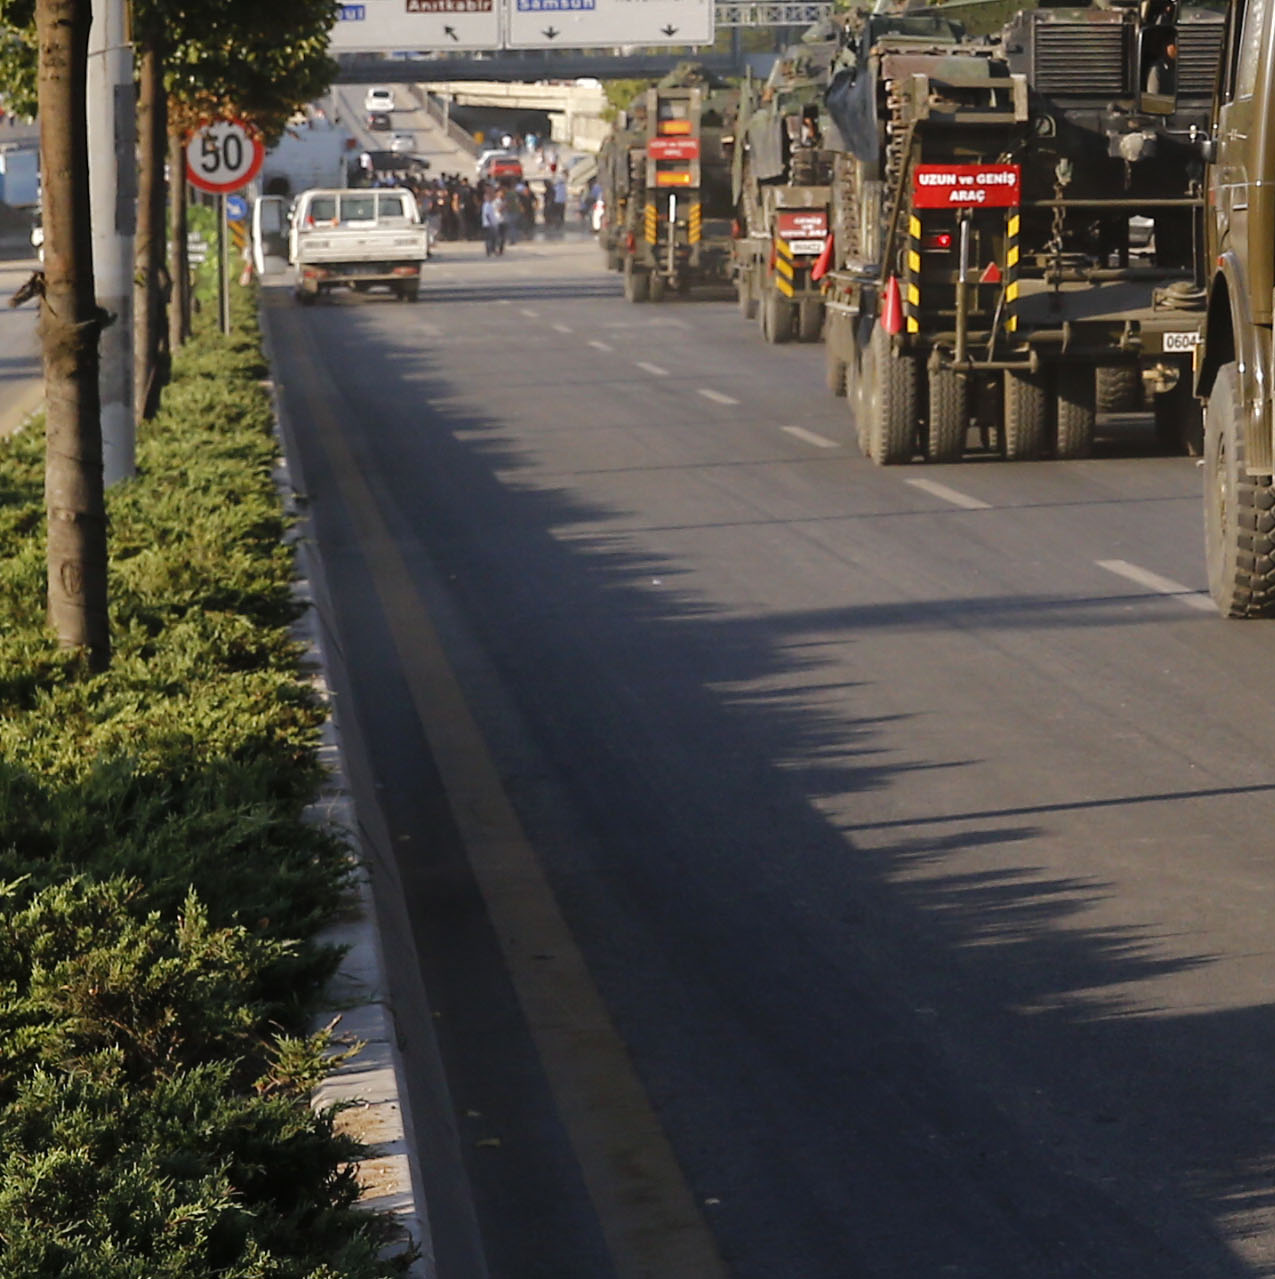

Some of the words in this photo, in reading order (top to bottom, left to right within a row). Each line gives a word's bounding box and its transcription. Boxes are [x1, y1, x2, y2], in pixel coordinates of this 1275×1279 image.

[201, 133, 243, 172] 50
[918, 173, 956, 186] UZUN
[957, 176, 974, 185] ve
[976, 171, 1016, 186] GENİŞ
[949, 190, 986, 202] ARAÇ
